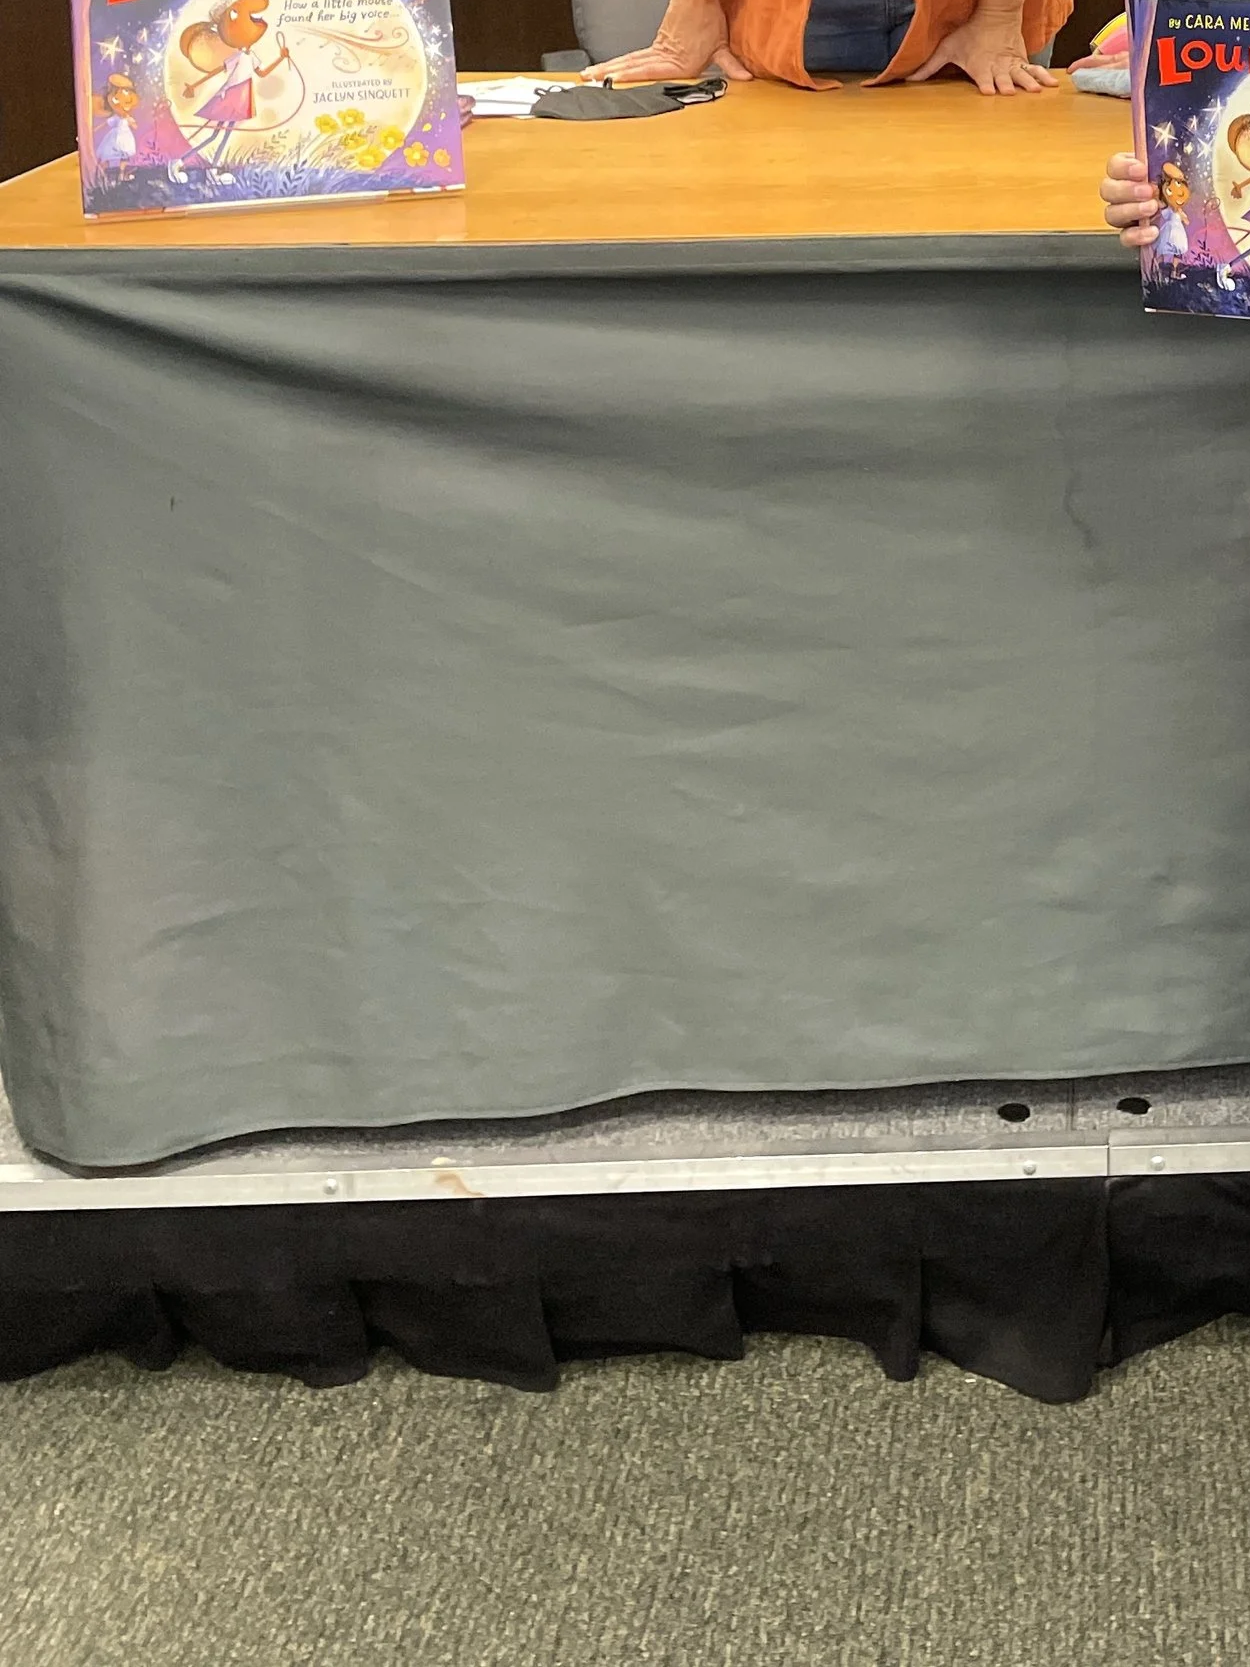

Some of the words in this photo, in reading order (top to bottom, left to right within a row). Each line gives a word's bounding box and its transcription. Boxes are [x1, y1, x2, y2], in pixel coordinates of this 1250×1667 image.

[284, 0, 307, 11] How
[311, 1, 319, 10] a
[276, 12, 312, 28] found
[317, 11, 335, 22] her
[340, 9, 357, 24] big
[1185, 14, 1225, 30] CARA
[313, 91, 354, 104] JACLYN
[357, 88, 411, 101] SINQUETT
